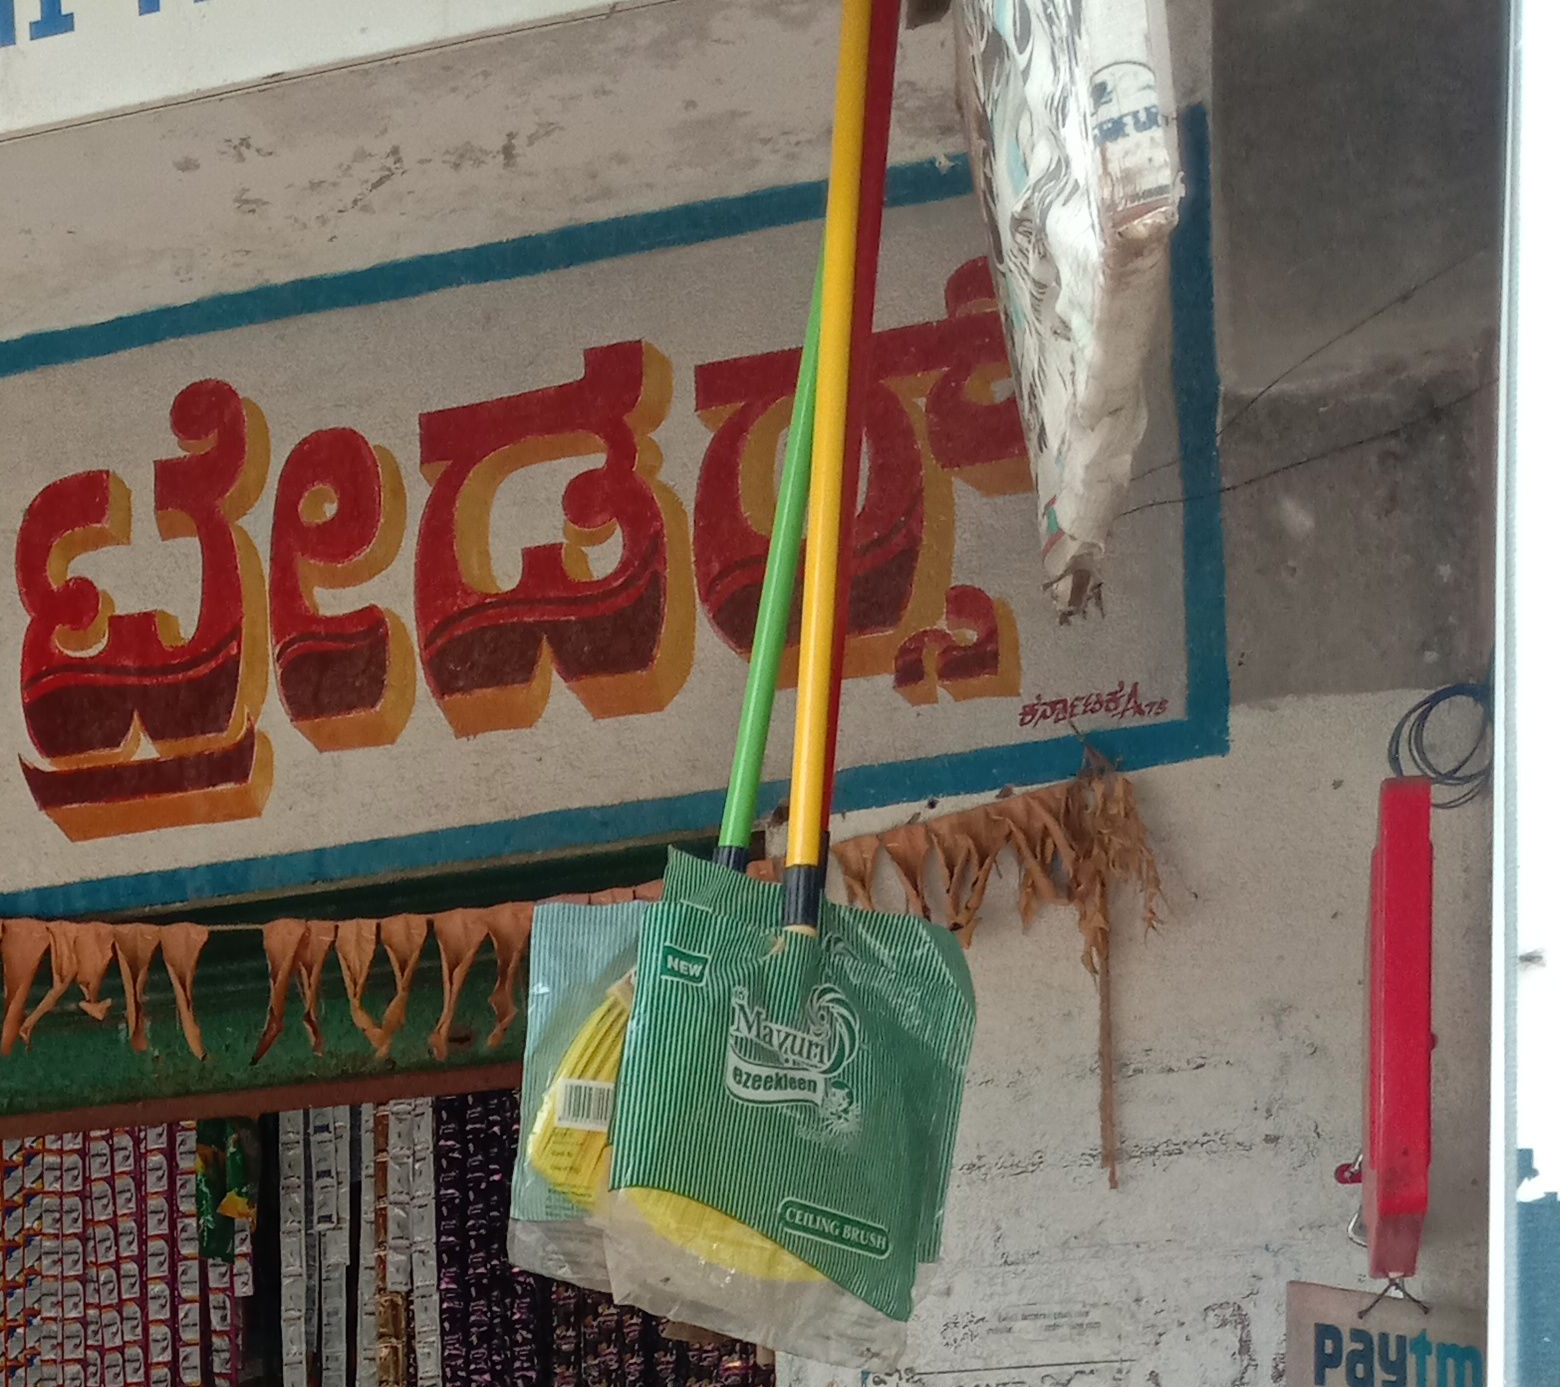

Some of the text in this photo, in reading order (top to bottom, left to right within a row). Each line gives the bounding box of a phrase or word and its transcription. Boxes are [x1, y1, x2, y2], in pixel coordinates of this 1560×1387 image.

[666, 954, 704, 979] NEW
[734, 1001, 827, 1067] Mayuri
[732, 1065, 819, 1094] ezeekleen
[785, 1206, 888, 1250] CEILING BRUSH
